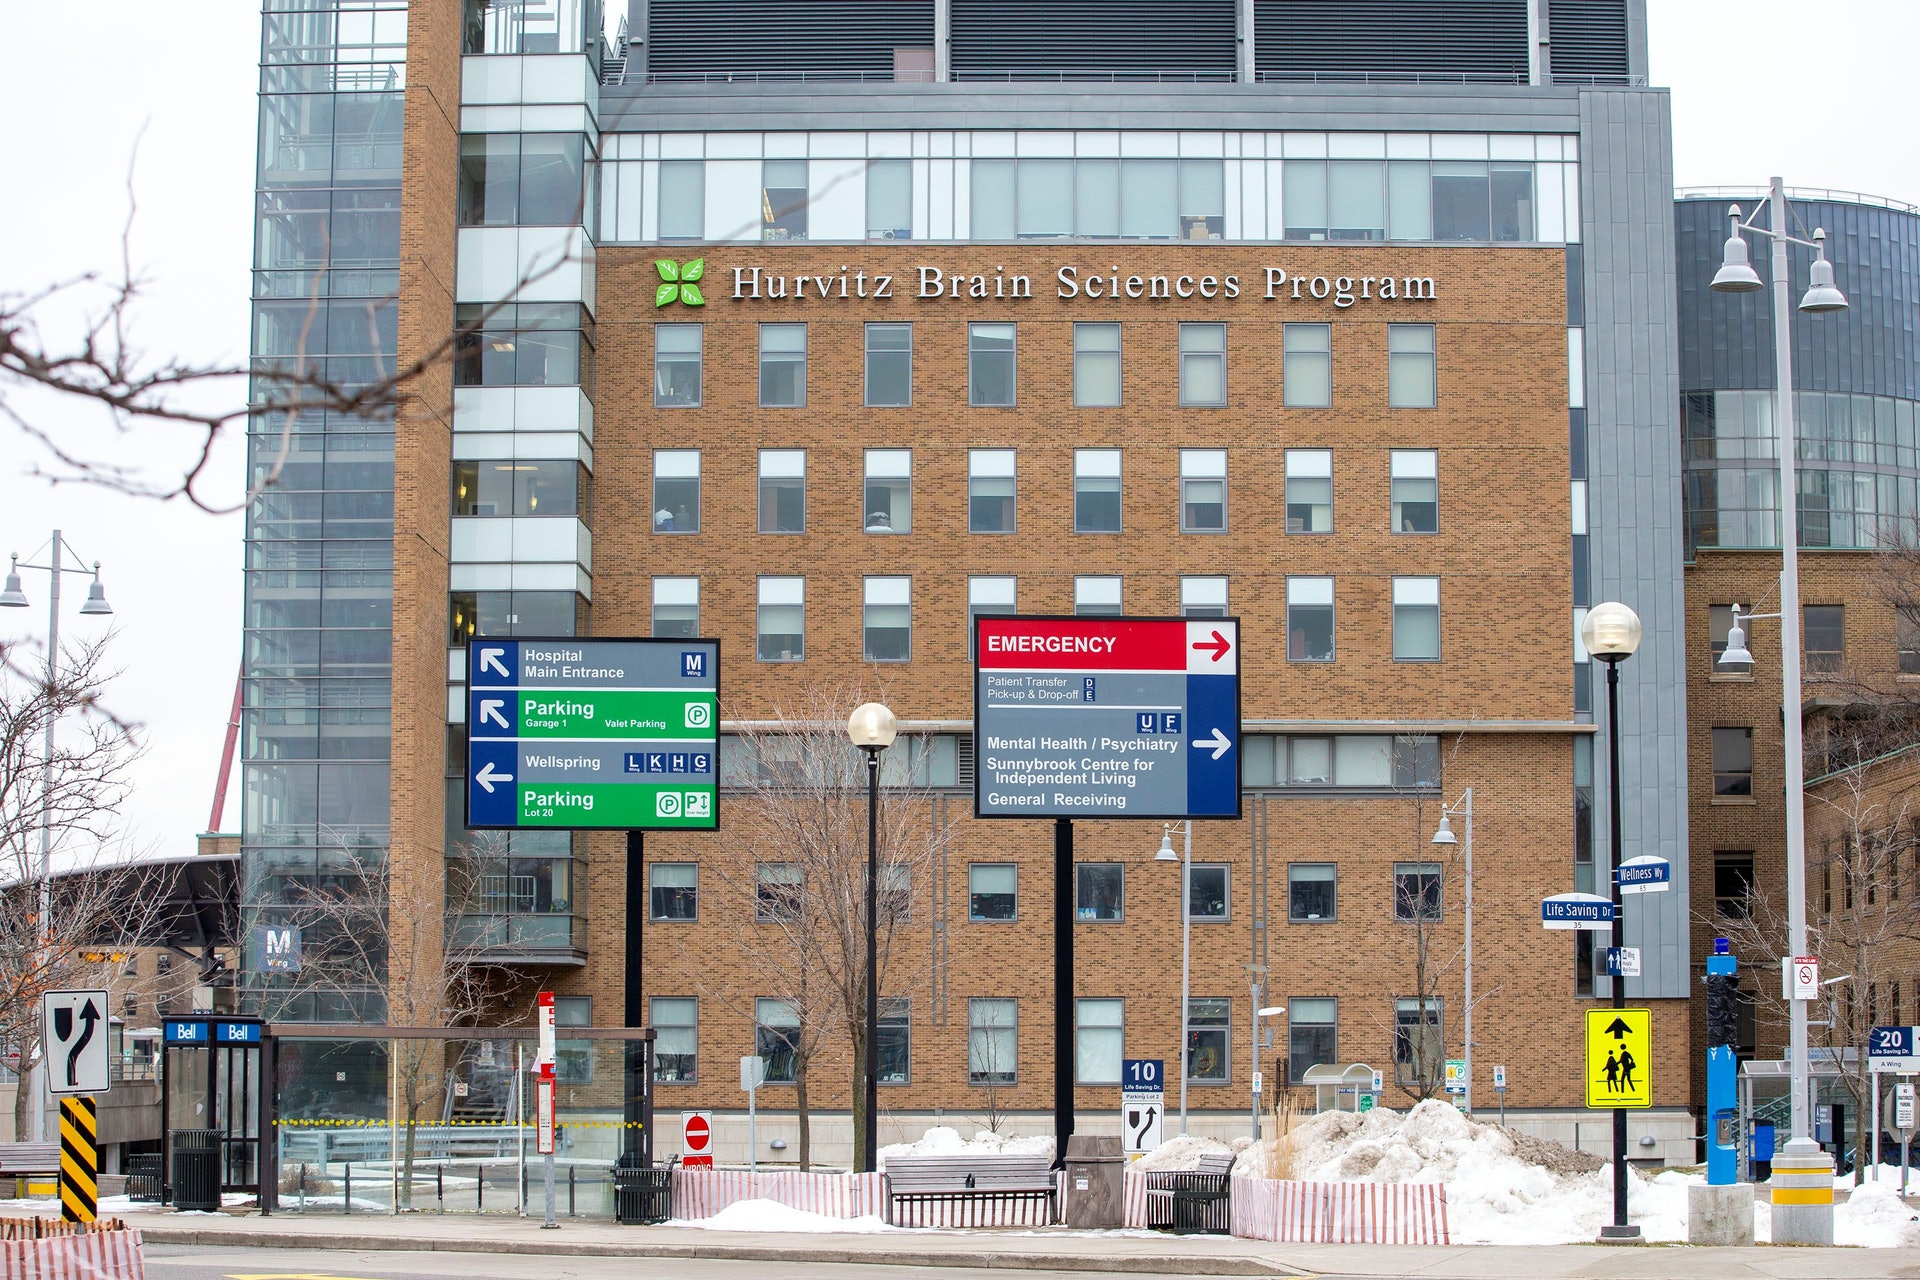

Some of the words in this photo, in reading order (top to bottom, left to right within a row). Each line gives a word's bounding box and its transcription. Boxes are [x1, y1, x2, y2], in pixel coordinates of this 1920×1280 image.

[731, 266, 893, 298] Hurvitz
[917, 266, 1032, 298] Brain
[1057, 266, 1240, 299] Sciences
[1263, 267, 1437, 308] Program
[988, 636, 1116, 653] EMERGENCY
[525, 650, 582, 663] Hospital
[686, 655, 701, 670] M
[525, 666, 558, 678] Main
[562, 666, 624, 678] Entrance
[988, 677, 1023, 686] Patient
[1026, 677, 1067, 687] Transfer
[988, 690, 1025, 700] Pick-up
[1028, 690, 1035, 698] &
[1038, 690, 1079, 701] Drop-off
[525, 700, 594, 719] Parking
[526, 719, 559, 728] Garage
[562, 719, 567, 727] 1
[605, 720, 628, 728] Valet
[630, 720, 666, 730] Parking
[1142, 715, 1152, 728] U
[1166, 715, 1176, 728] F
[988, 737, 1036, 749] Mental
[1040, 737, 1087, 750] Health
[1092, 738, 1096, 750] /
[1101, 738, 1178, 753] Psychiatry
[526, 756, 600, 770] Wellspring
[630, 755, 638, 767] L
[650, 755, 661, 767] K
[673, 755, 683, 767] H
[694, 755, 706, 768] G
[987, 758, 1076, 773] Sunnybrook
[1081, 759, 1130, 771] Centre
[1133, 758, 1154, 771] for
[995, 772, 1087, 786] Independent
[1092, 772, 1136, 787] Living
[524, 791, 594, 810] Parking
[988, 793, 1045, 805] General
[1054, 794, 1126, 808] Receiving
[1621, 868, 1652, 881] Wellness
[1654, 868, 1663, 879] Wy
[1546, 903, 1563, 916] Life
[1566, 904, 1598, 919] Saving
[1602, 907, 1610, 916] Dr
[267, 930, 290, 953] M
[178, 1024, 196, 1039] Bell
[229, 1025, 247, 1039] Bell
[1880, 1031, 1902, 1047] 20
[1131, 1062, 1155, 1081] 10
